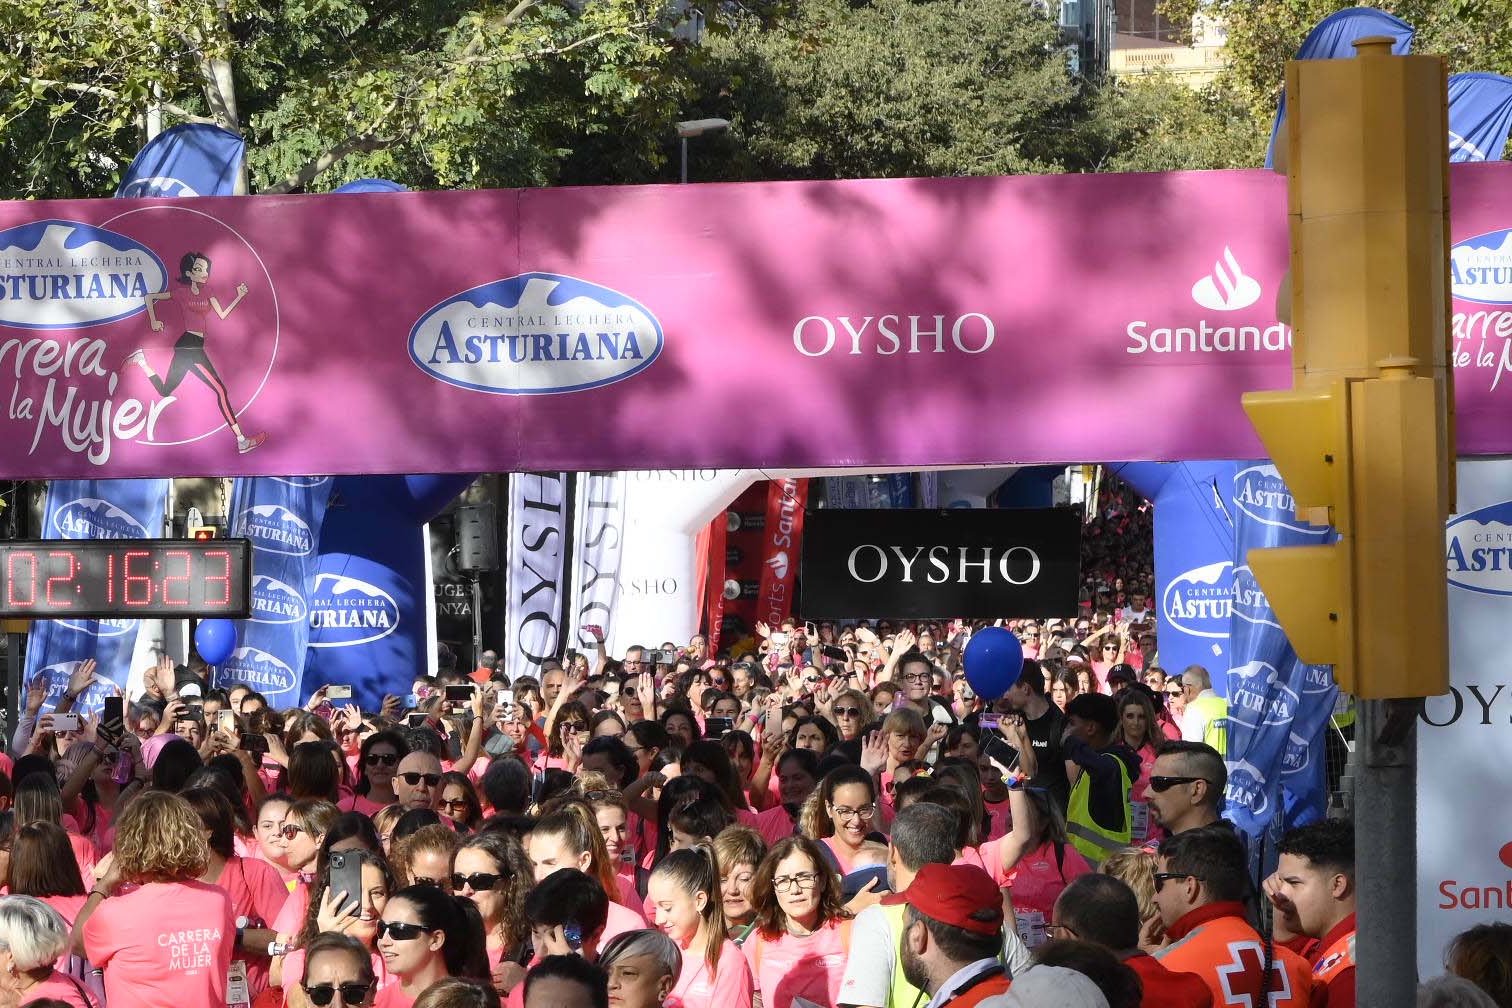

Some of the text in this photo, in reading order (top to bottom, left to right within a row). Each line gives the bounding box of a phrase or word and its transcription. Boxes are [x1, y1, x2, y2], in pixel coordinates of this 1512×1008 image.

[70, 255, 143, 269] LECHERA
[467, 315, 546, 329] CENTRAL
[792, 311, 996, 357] OYSHO
[427, 319, 644, 365] ASTURIANA
[1126, 319, 1292, 355] Santand
[1476, 340, 1494, 368] la
[8, 381, 34, 420] la
[28, 373, 178, 467] Mujer
[239, 522, 310, 551] ASTURIANA
[847, 543, 1042, 585] OYSHO
[8, 551, 230, 606] 02:16:23
[336, 598, 386, 608] LECHERA
[1419, 685, 1512, 728] OY
[1031, 739, 1048, 748] Huel
[157, 928, 223, 948] CARRERA
[171, 943, 211, 959] DE LA
[169, 955, 212, 971] MUJER
